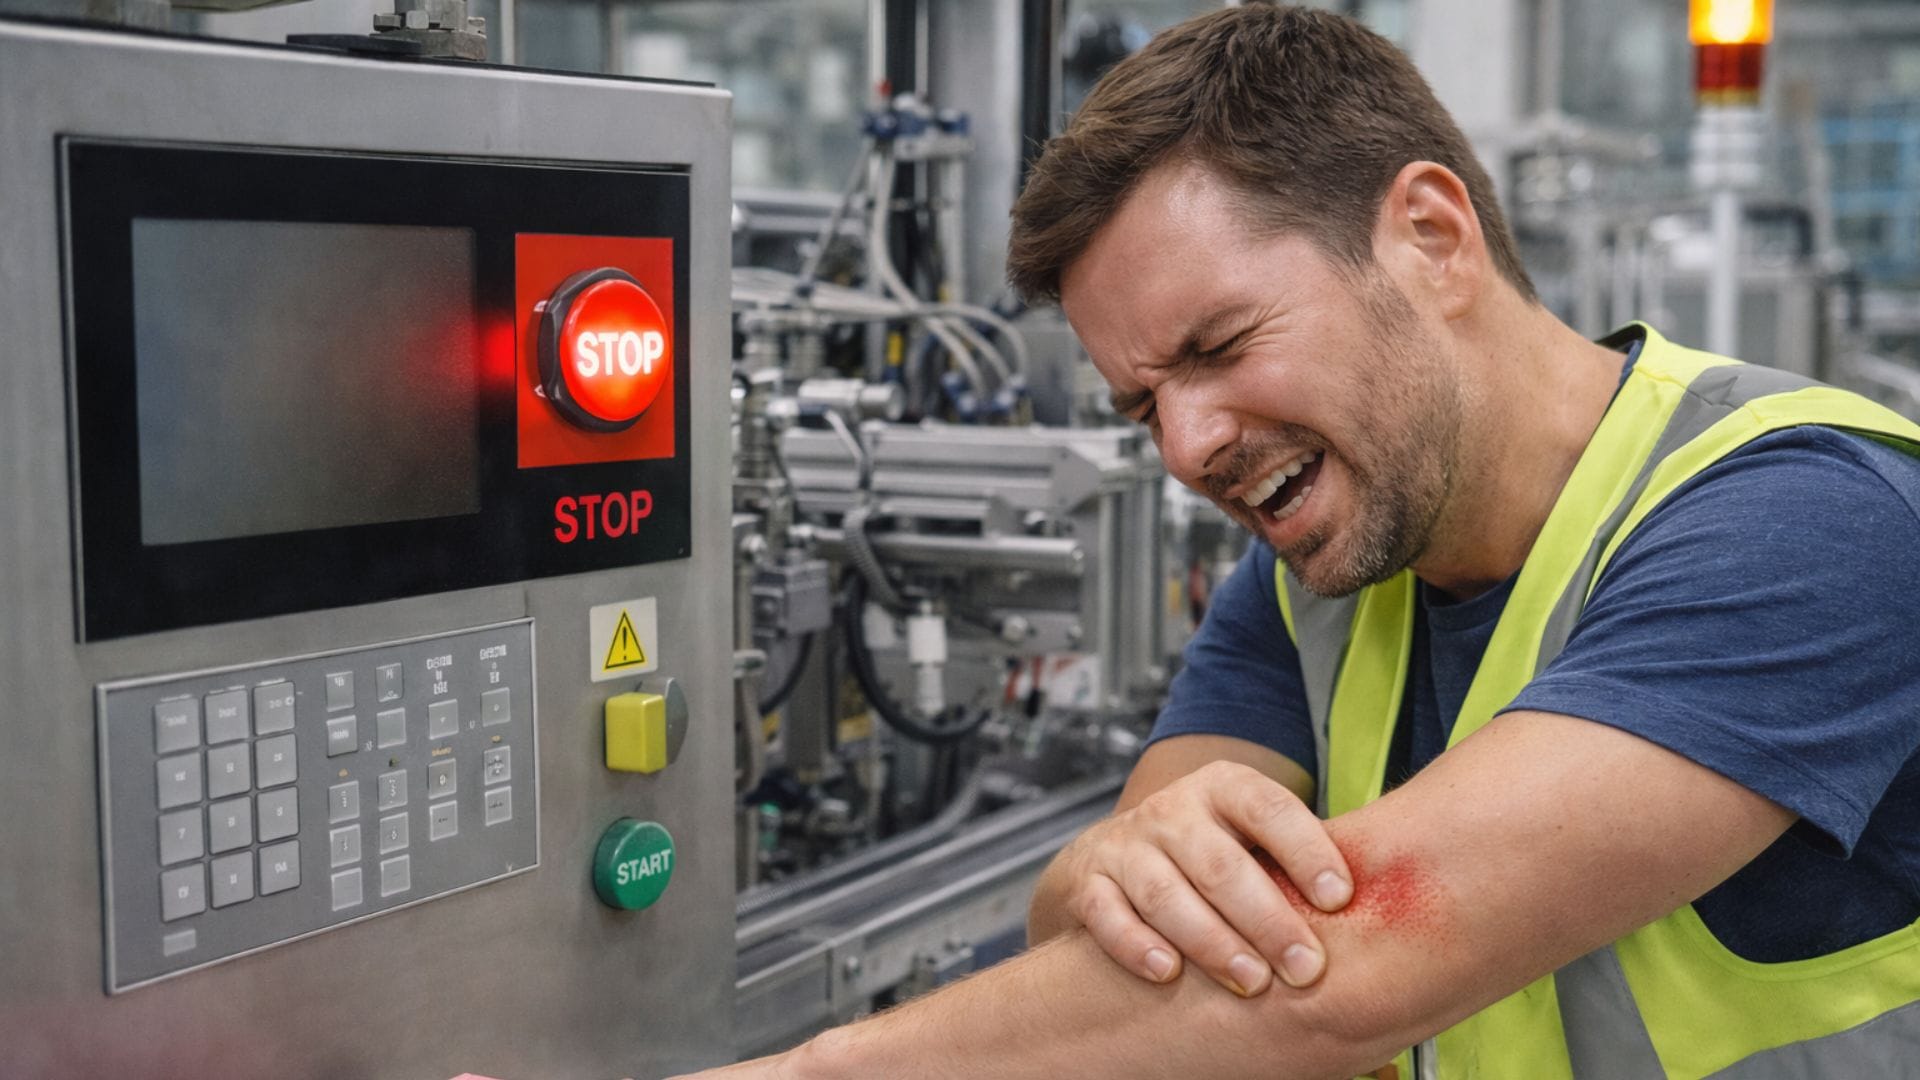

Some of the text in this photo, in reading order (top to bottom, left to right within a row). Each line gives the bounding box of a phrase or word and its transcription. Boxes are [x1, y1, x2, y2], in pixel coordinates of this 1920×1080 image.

[576, 330, 665, 378] STOP
[554, 489, 653, 543] STOP
[616, 848, 672, 885] START
